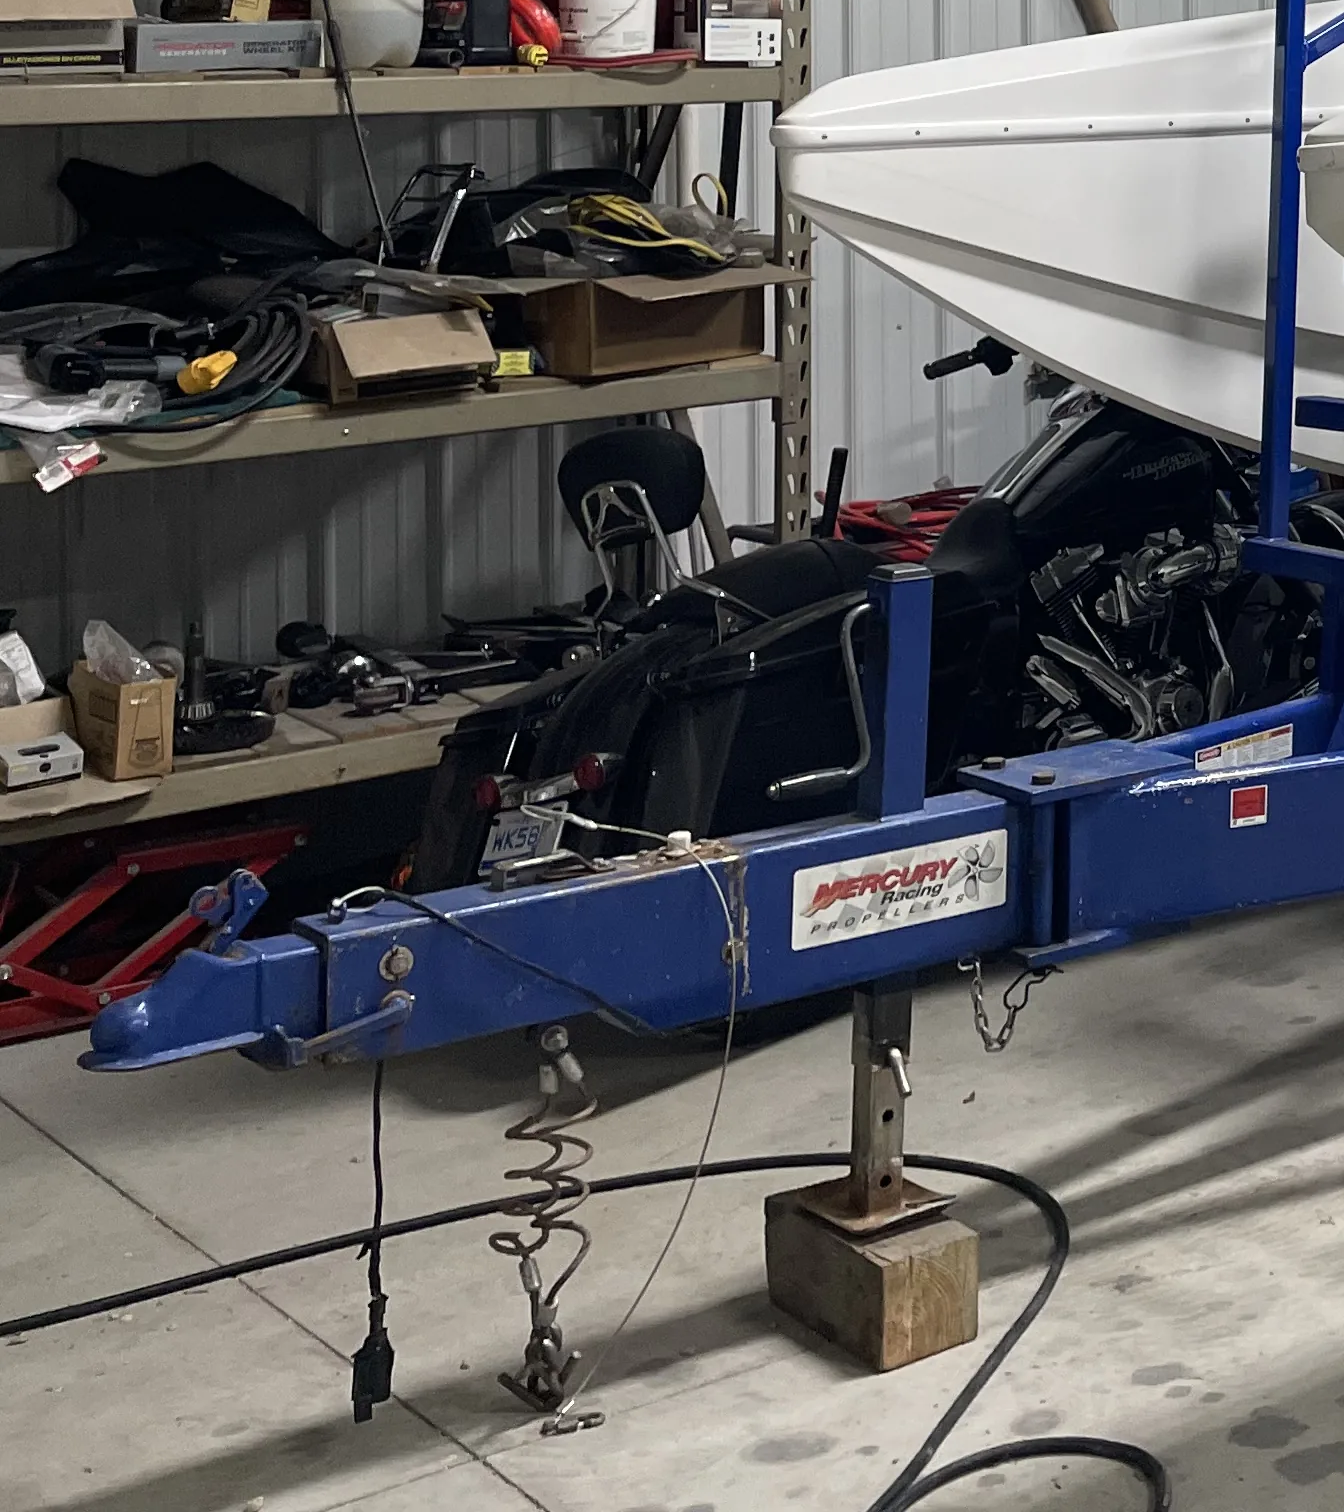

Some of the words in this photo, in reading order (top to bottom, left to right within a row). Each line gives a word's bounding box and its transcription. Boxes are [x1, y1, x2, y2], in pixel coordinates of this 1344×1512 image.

[243, 46, 284, 55] WHEEL
[810, 856, 959, 905] MERCURY
[880, 883, 944, 906] Racing
[810, 892, 966, 935] PROPELLERS
